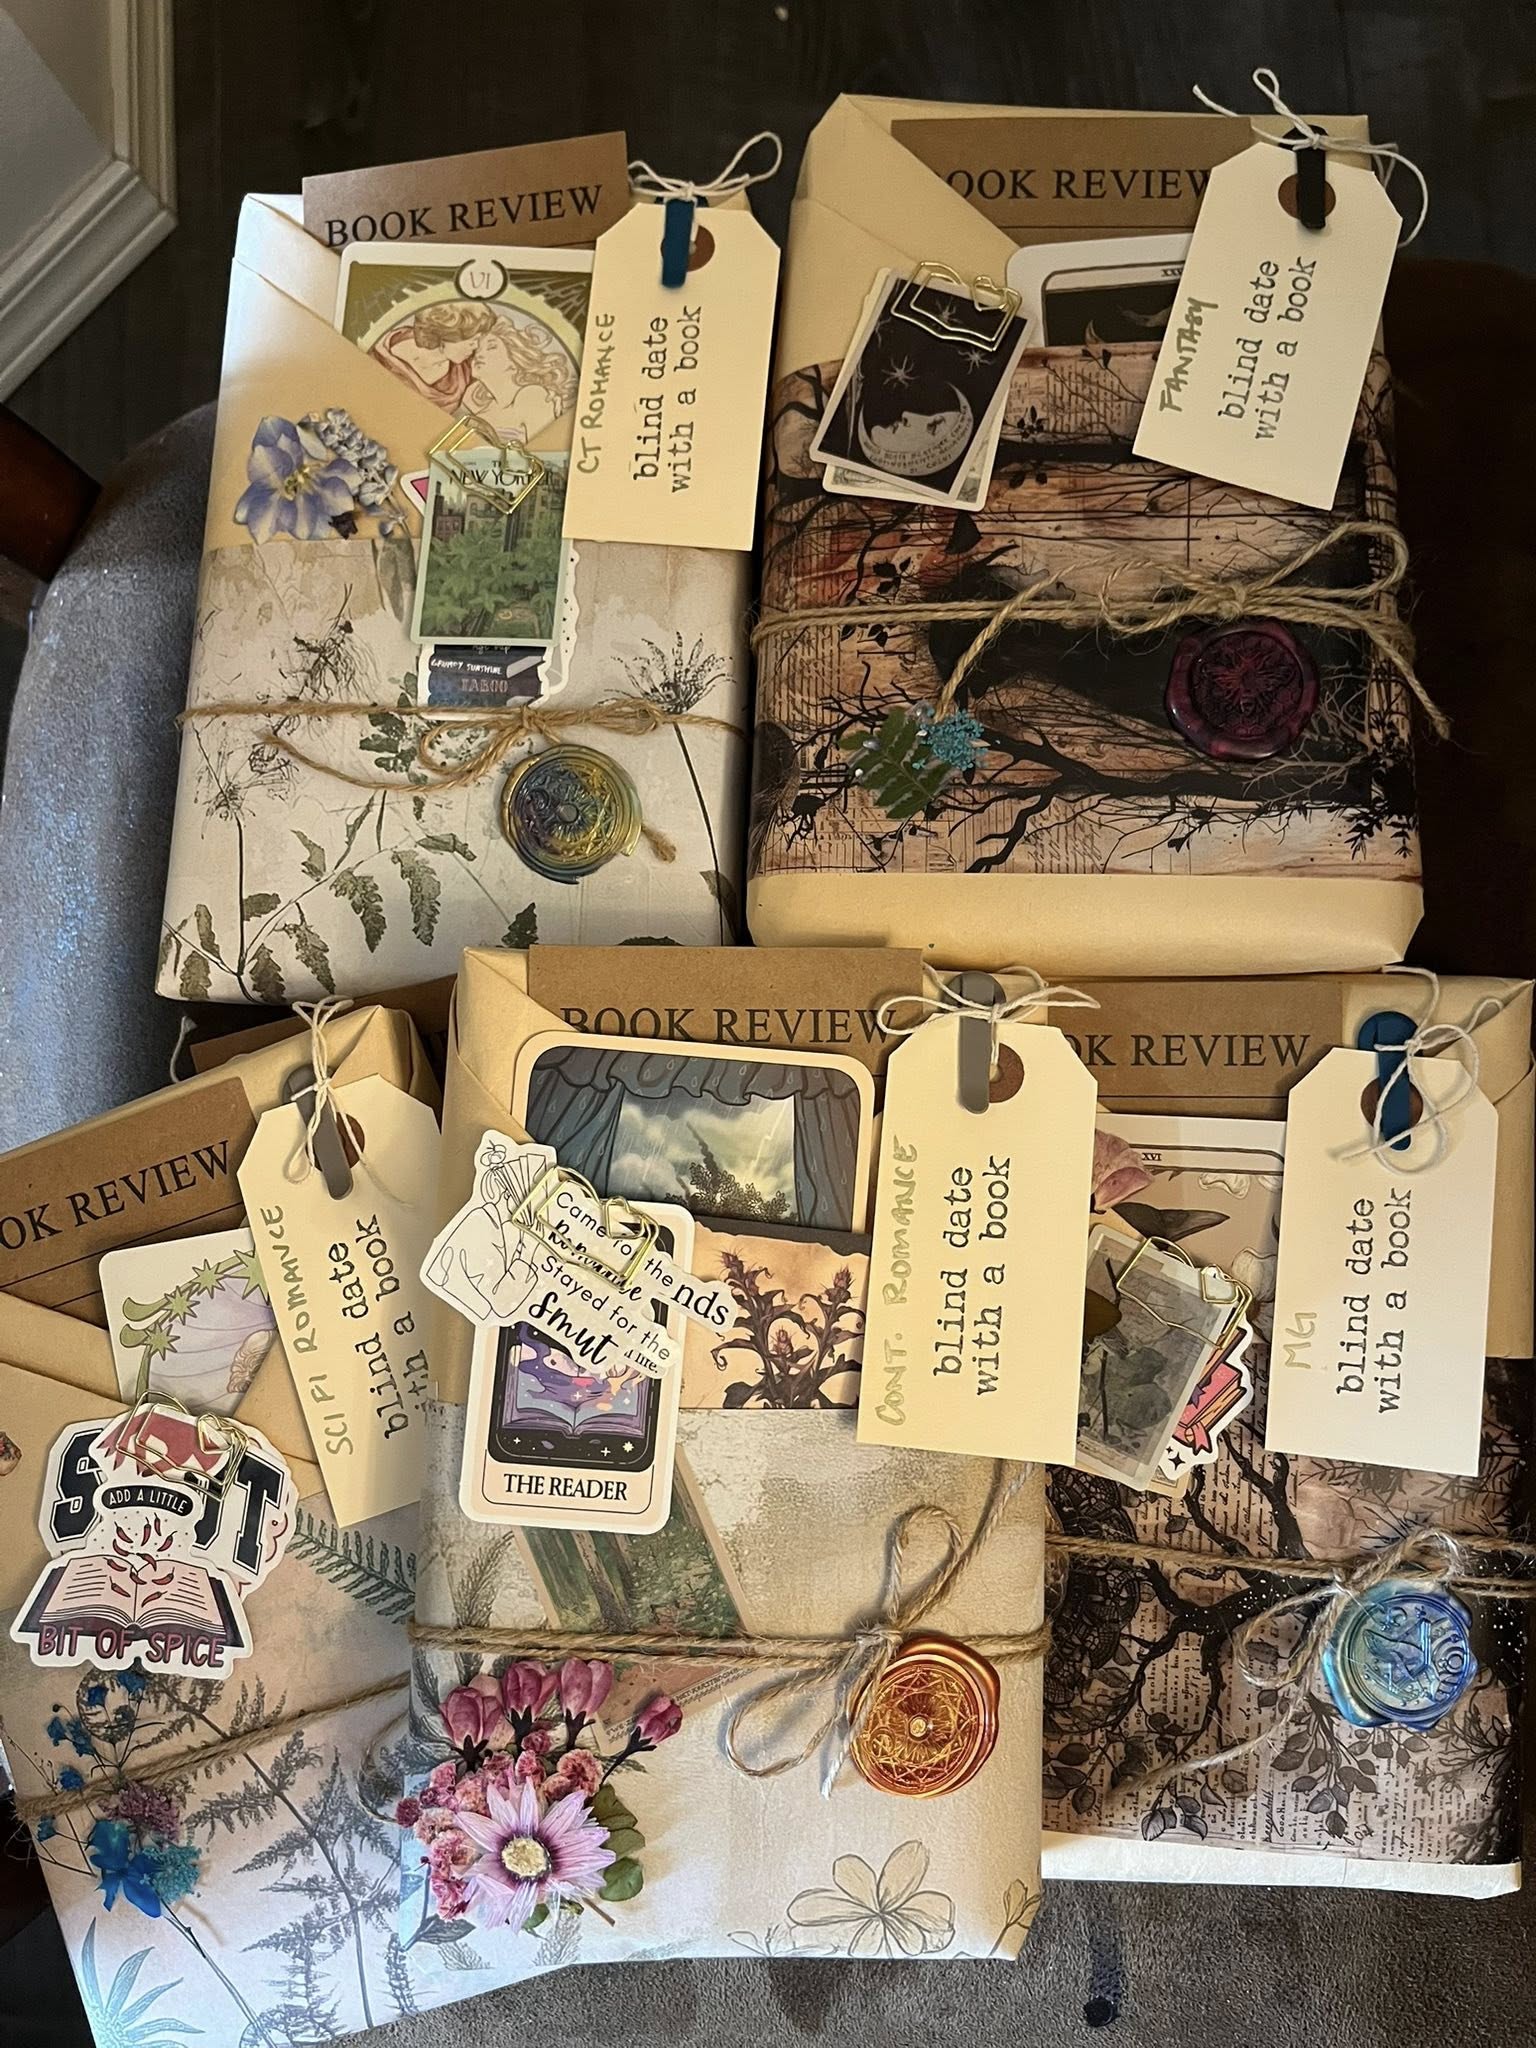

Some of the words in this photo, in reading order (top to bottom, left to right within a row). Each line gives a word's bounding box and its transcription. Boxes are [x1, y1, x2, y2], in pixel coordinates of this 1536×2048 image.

[325, 207, 436, 247] BOOK
[448, 184, 603, 233] REVIEW
[946, 169, 1038, 199] OOK
[1277, 256, 1317, 323] book
[580, 313, 615, 429] ROMANCE
[642, 317, 669, 380] date
[673, 305, 702, 372] book
[1159, 297, 1219, 413] FANTASY
[1217, 337, 1263, 419] blind
[1243, 260, 1280, 324] date
[1276, 341, 1298, 357] a
[677, 388, 696, 405] a
[1255, 372, 1290, 440] with
[576, 436, 602, 474] CT
[633, 394, 664, 481] blind
[668, 421, 694, 493] with
[559, 1007, 699, 1042] BOOK
[713, 1008, 897, 1044] REVIEW
[1130, 1034, 1311, 1067] REVIEW
[0, 1203, 63, 1250] OK
[65, 1140, 229, 1228] REVIEW
[882, 1134, 918, 1306] ROMANCE
[942, 1166, 973, 1248] date
[979, 1155, 1011, 1241] book
[1380, 1187, 1412, 1268] book
[355, 1214, 400, 1302] book
[556, 1191, 609, 1238] Came
[644, 1258, 673, 1286] the
[1345, 1198, 1375, 1275] date
[328, 1241, 370, 1320] date
[541, 1255, 610, 1312] Stayed
[607, 1306, 638, 1334] for
[640, 1331, 670, 1360] the
[983, 1264, 1005, 1285] a
[1386, 1290, 1407, 1310] a
[393, 1310, 416, 1336] a
[933, 1268, 968, 1376] blind
[972, 1305, 1002, 1396] with
[1336, 1294, 1370, 1395] blind
[354, 1331, 410, 1440] blind
[1374, 1329, 1404, 1414] with
[323, 1412, 354, 1456] SCI
[109, 1488, 131, 1505] ADD
[137, 1488, 144, 1501] A
[149, 1489, 188, 1513] LITTLE
[503, 1473, 545, 1495] THE
[549, 1477, 628, 1501] READER
[38, 1624, 84, 1657] BIT
[95, 1627, 135, 1660] OF
[145, 1631, 227, 1668] SPICE
